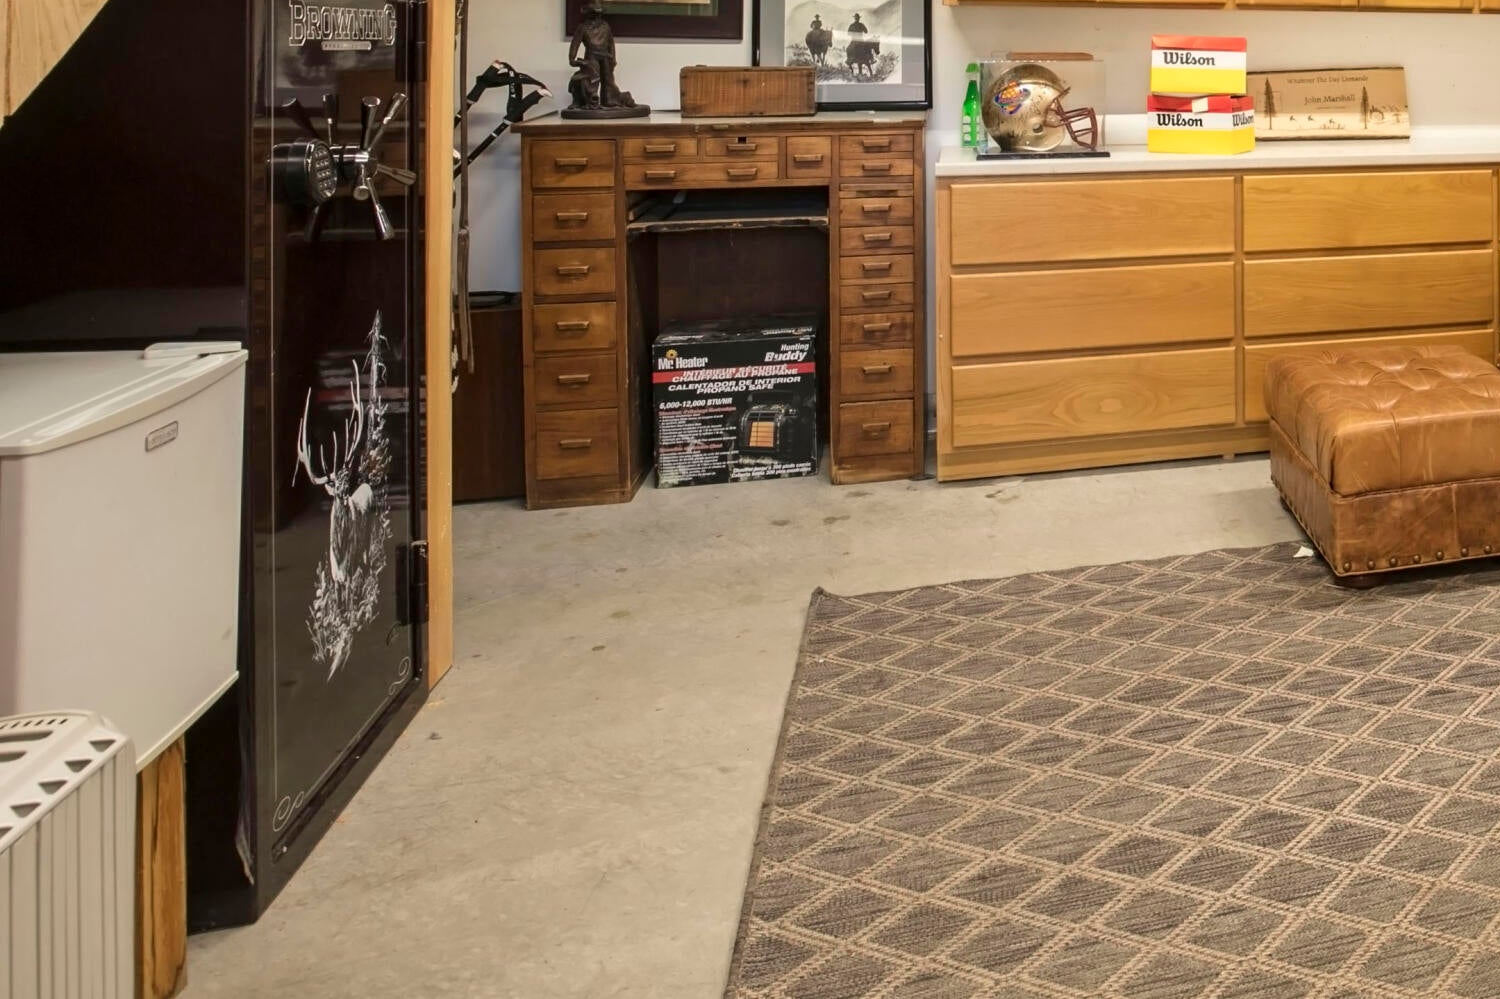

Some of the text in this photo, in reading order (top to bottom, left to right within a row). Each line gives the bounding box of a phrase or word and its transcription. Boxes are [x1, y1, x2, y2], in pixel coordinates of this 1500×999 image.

[1163, 51, 1216, 66] Wilson
[1304, 94, 1356, 105] John Marshall
[1156, 113, 1203, 127] Wilson
[1232, 112, 1255, 127] Wilson
[780, 343, 809, 351] Hunting
[676, 357, 708, 369] Heater
[764, 351, 807, 362] Buddy
[672, 368, 798, 383] CHAUFFAGE AU PROPANE
[668, 380, 737, 392] CALENTADOR
[754, 376, 801, 385] INTERIOR
[696, 383, 774, 394] PROPANO SAFE
